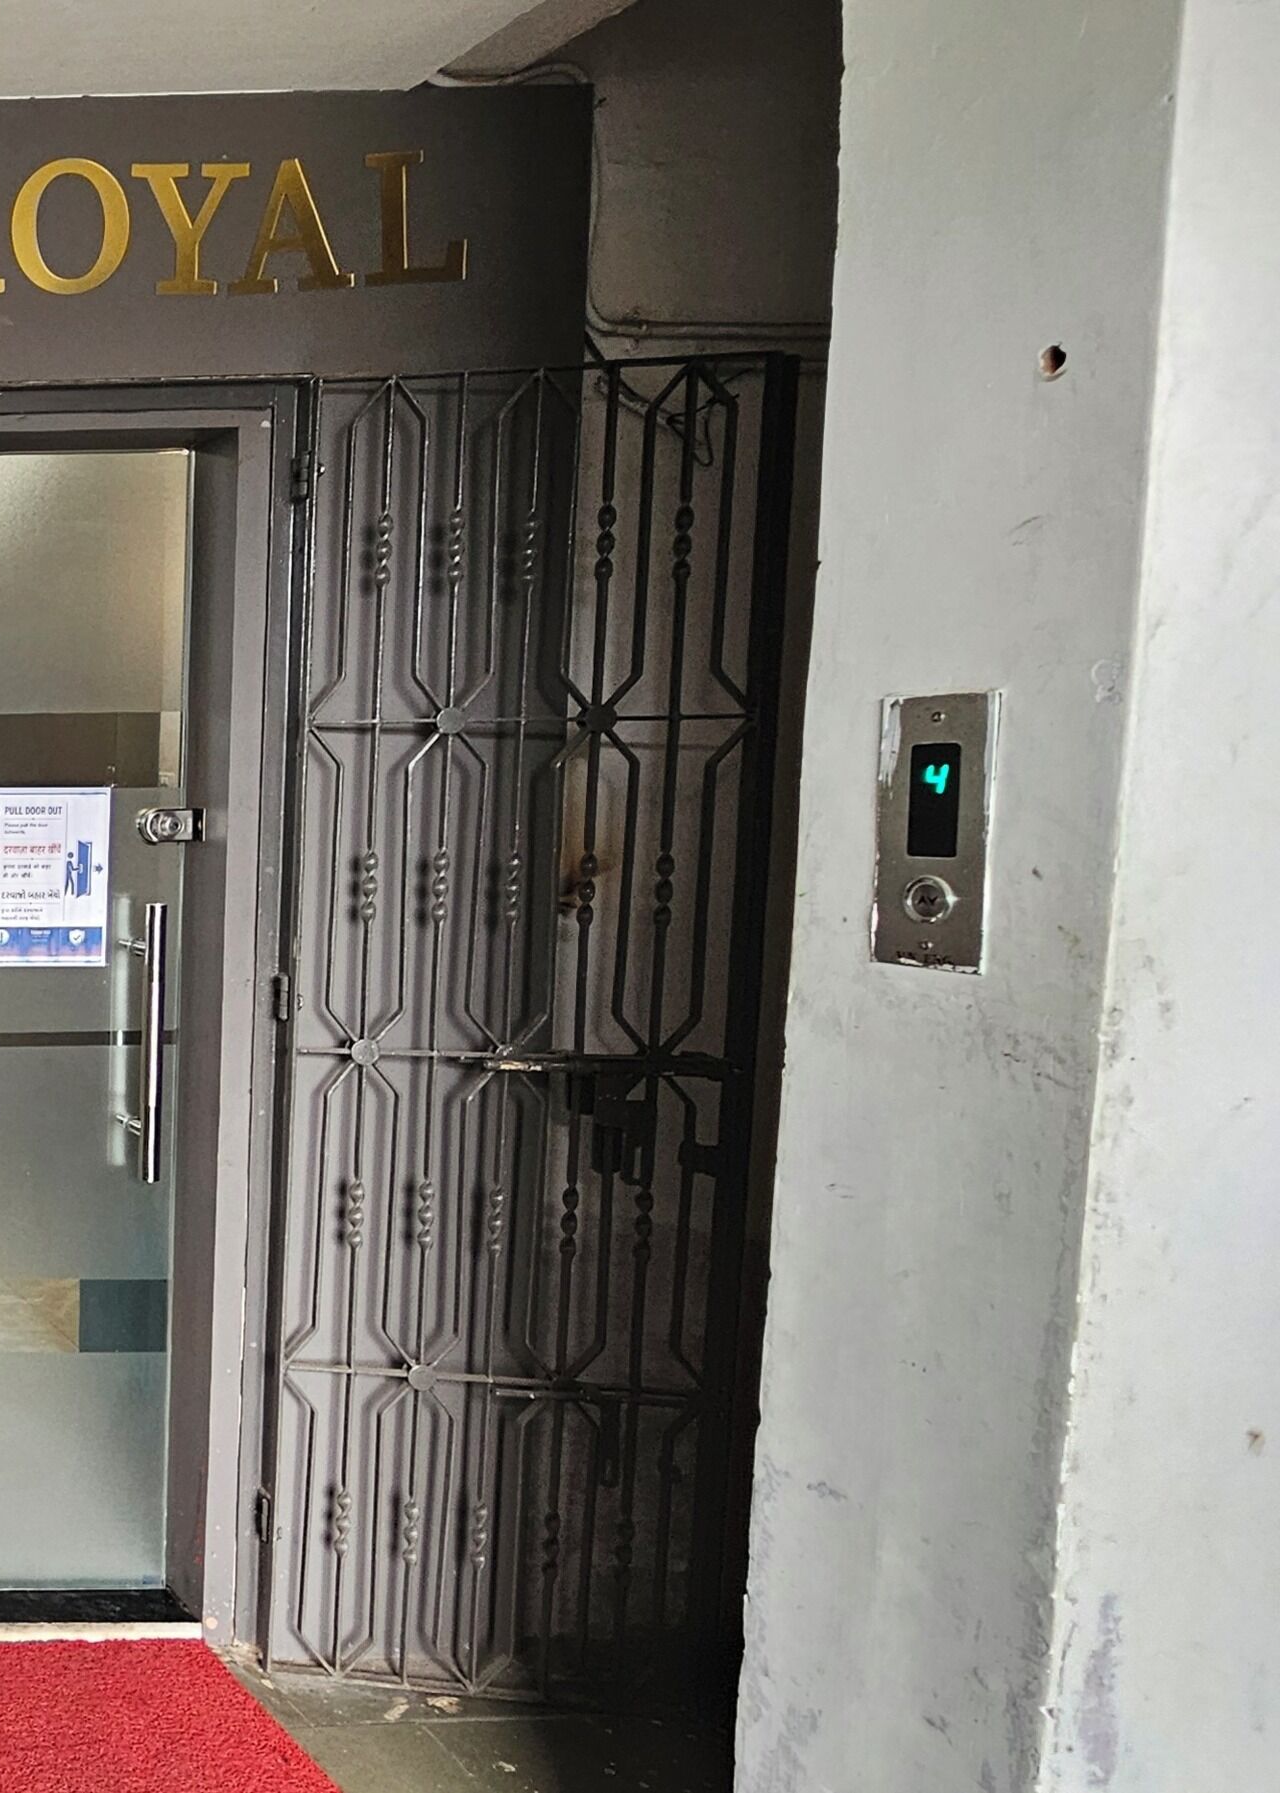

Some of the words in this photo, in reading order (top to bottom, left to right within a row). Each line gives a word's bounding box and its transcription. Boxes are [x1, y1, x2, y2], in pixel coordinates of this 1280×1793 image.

[923, 763, 950, 795] 4
[4, 806, 23, 816] PULL
[25, 806, 46, 816] DOOR
[47, 806, 62, 816] OUT
